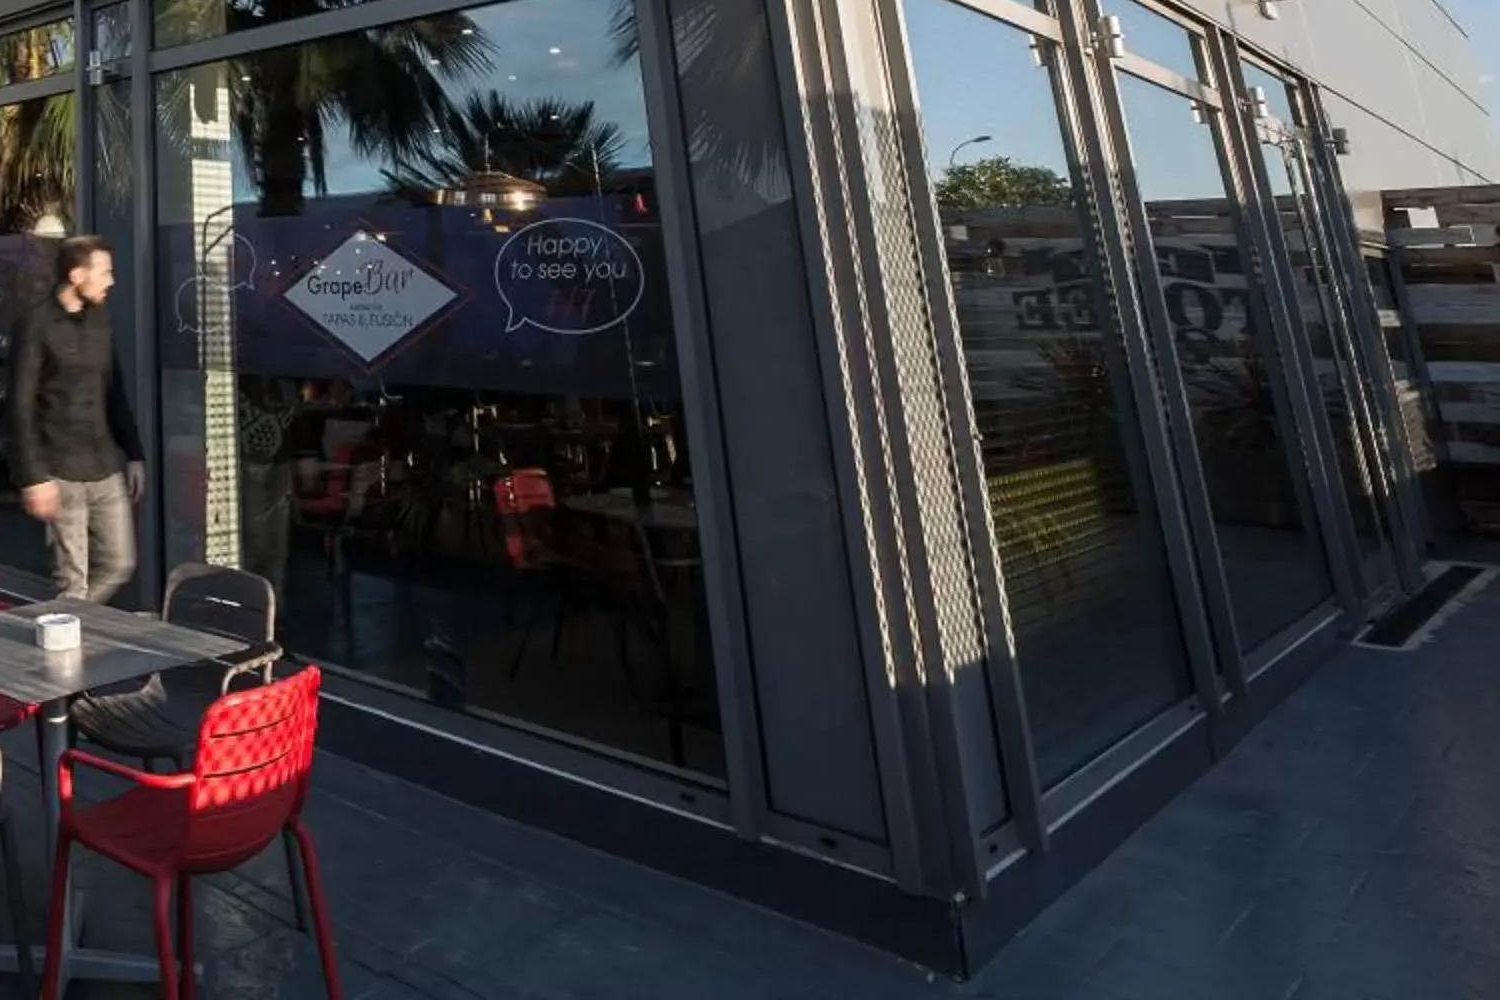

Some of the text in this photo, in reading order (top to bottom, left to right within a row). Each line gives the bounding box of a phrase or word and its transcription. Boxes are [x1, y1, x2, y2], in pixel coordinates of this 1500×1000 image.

[526, 233, 603, 258] Happy
[510, 259, 627, 285] to see you
